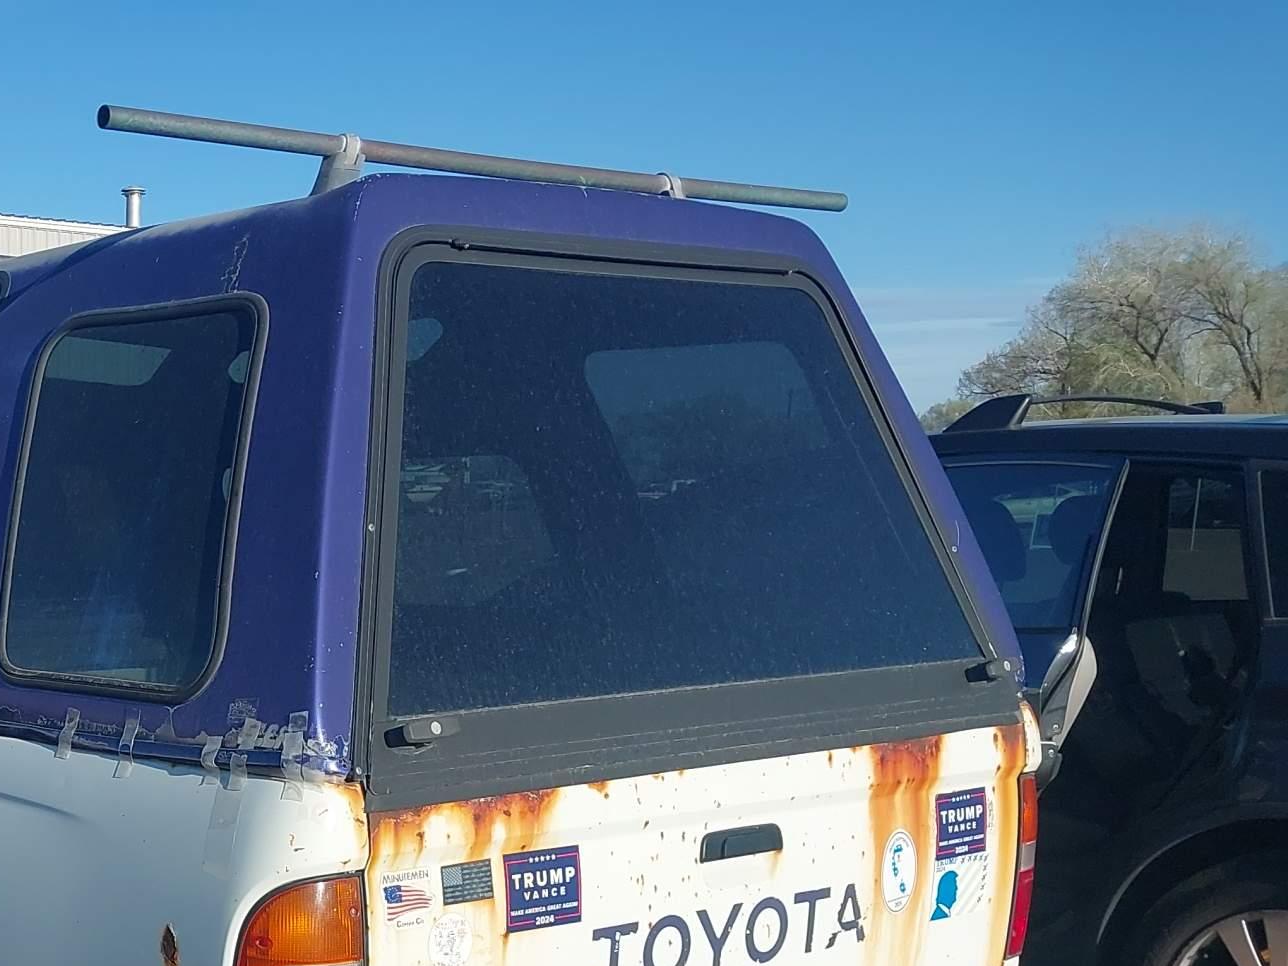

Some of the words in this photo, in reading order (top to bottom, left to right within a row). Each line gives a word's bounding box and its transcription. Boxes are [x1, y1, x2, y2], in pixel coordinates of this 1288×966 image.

[940, 804, 983, 825] TRUMP
[947, 821, 977, 834] VANCE
[382, 869, 429, 885] MINUTEMEN
[511, 866, 576, 890] TRUMP
[523, 886, 566, 901] VANCE
[535, 914, 555, 925] 2024
